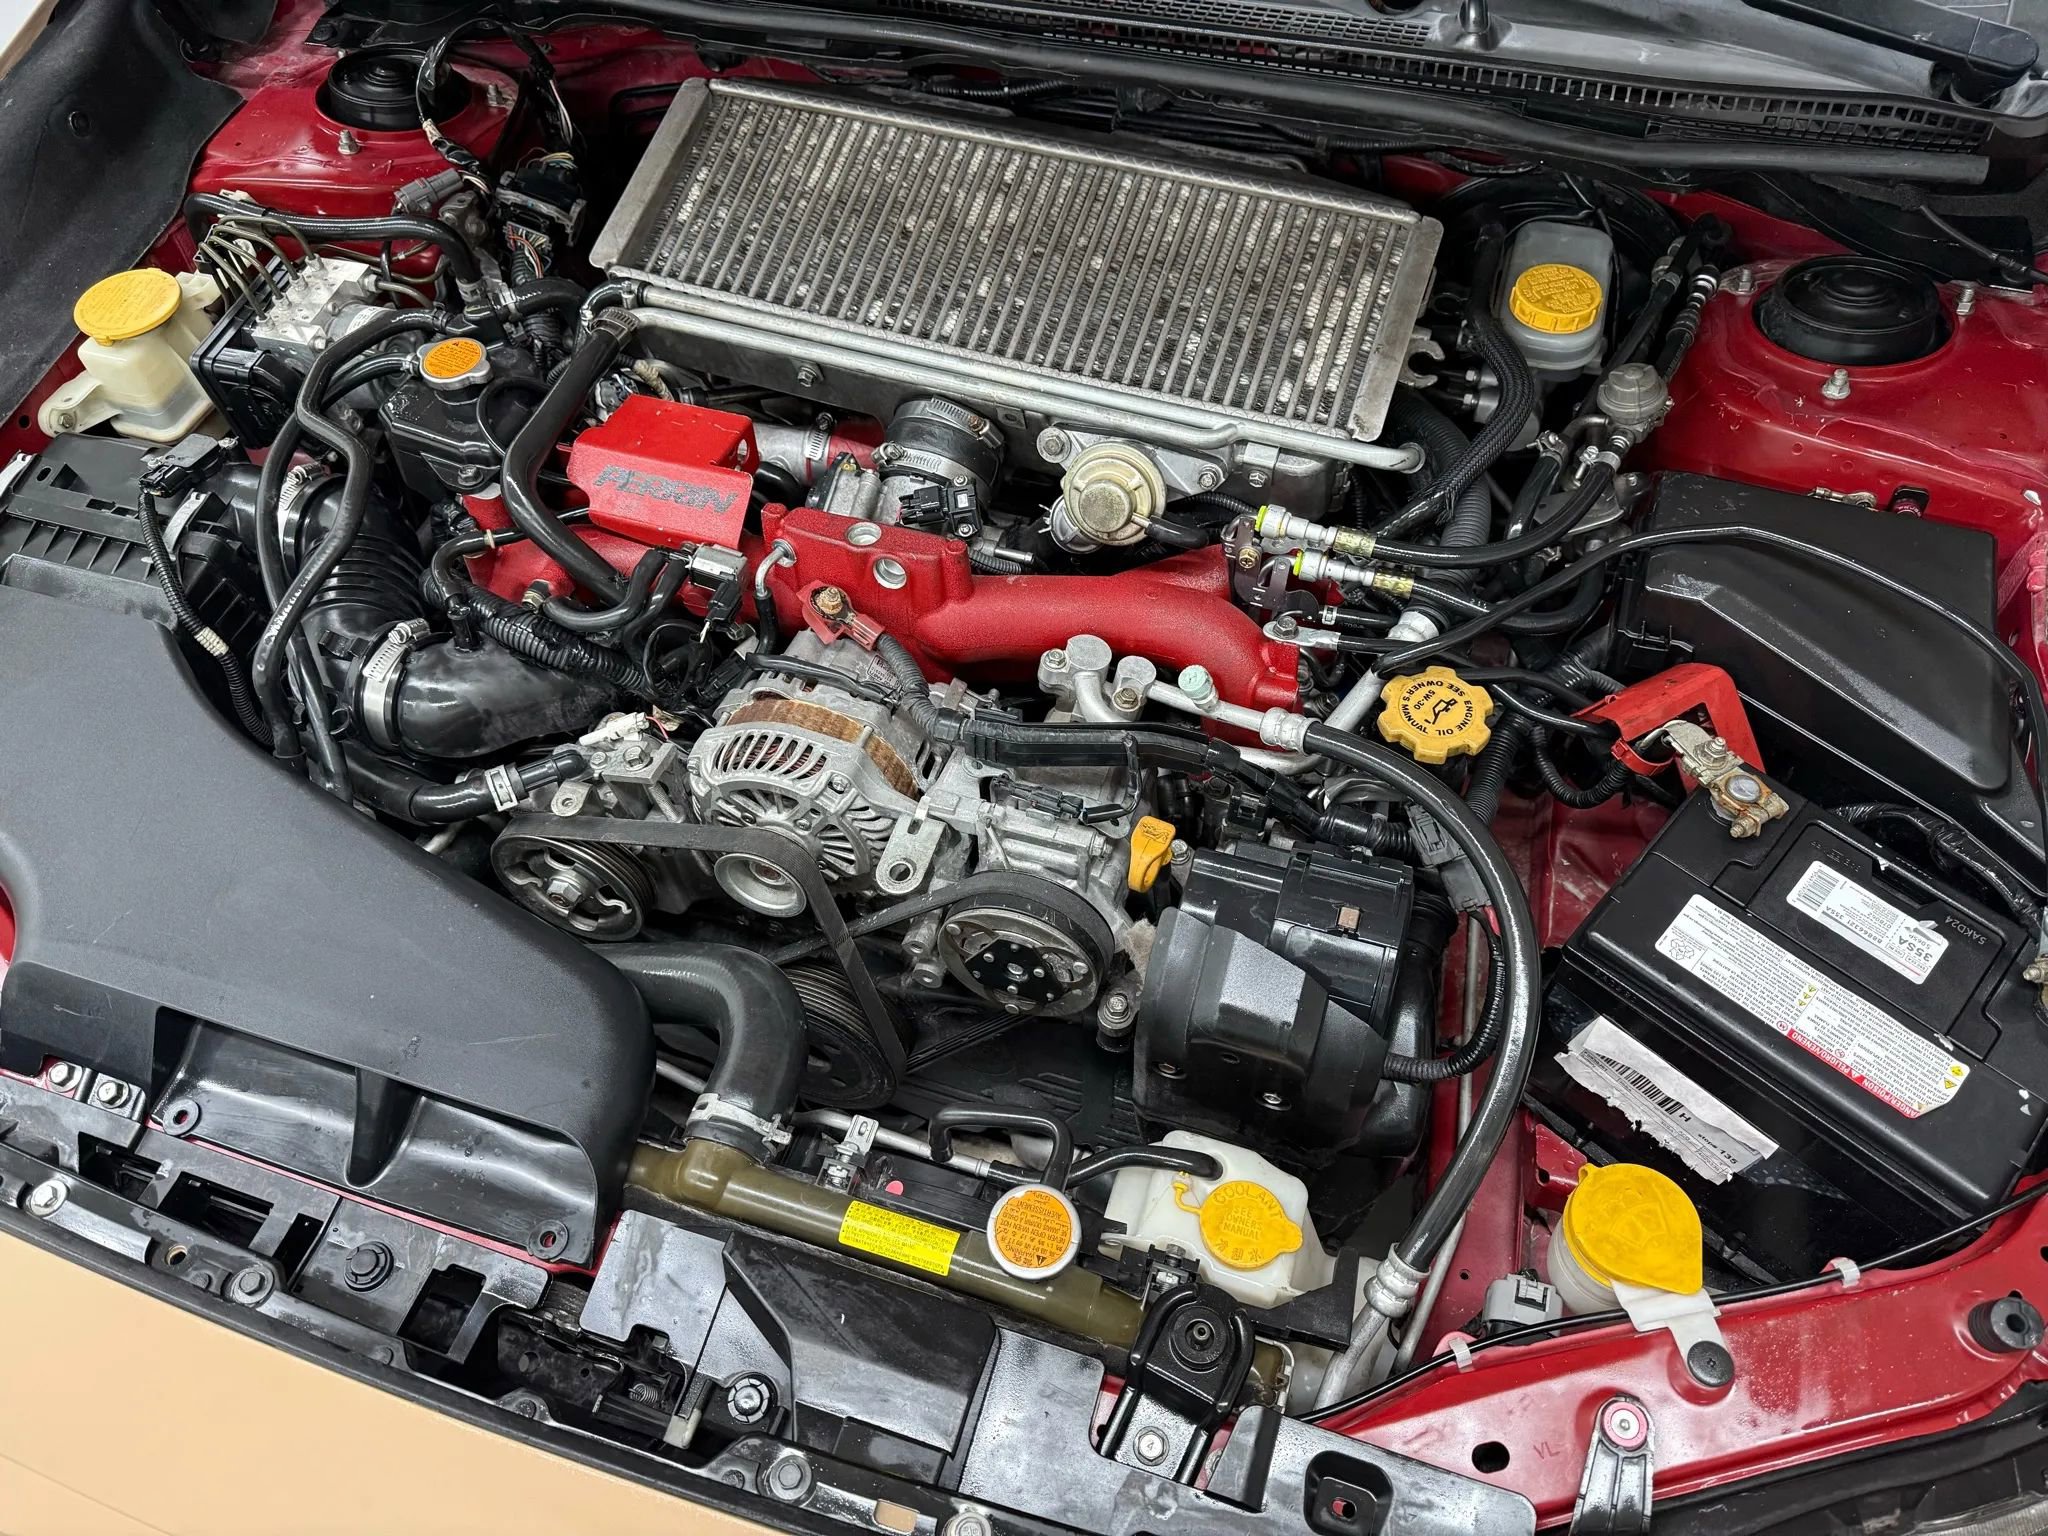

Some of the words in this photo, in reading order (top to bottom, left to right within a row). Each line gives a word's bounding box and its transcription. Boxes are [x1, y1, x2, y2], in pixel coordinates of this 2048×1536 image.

[1446, 682, 1465, 697] SEE
[1401, 703, 1429, 734] MANUAL
[1457, 700, 1474, 731] ENGINE
[1435, 728, 1454, 737] OIL
[1895, 934, 1933, 962] 35SA
[1790, 1030, 1851, 1073] PELIGRO/VENENO
[1679, 1113, 1692, 1122] H
[1719, 1149, 1738, 1164] 135
[1213, 1184, 1283, 1219] COOLANT
[1233, 1206, 1253, 1218] SEE
[1225, 1214, 1263, 1230] OWNERS
[1223, 1221, 1261, 1241] MANUAL
[1046, 1234, 1065, 1244] NEVER
[1004, 1245, 1033, 1257] WARNING
